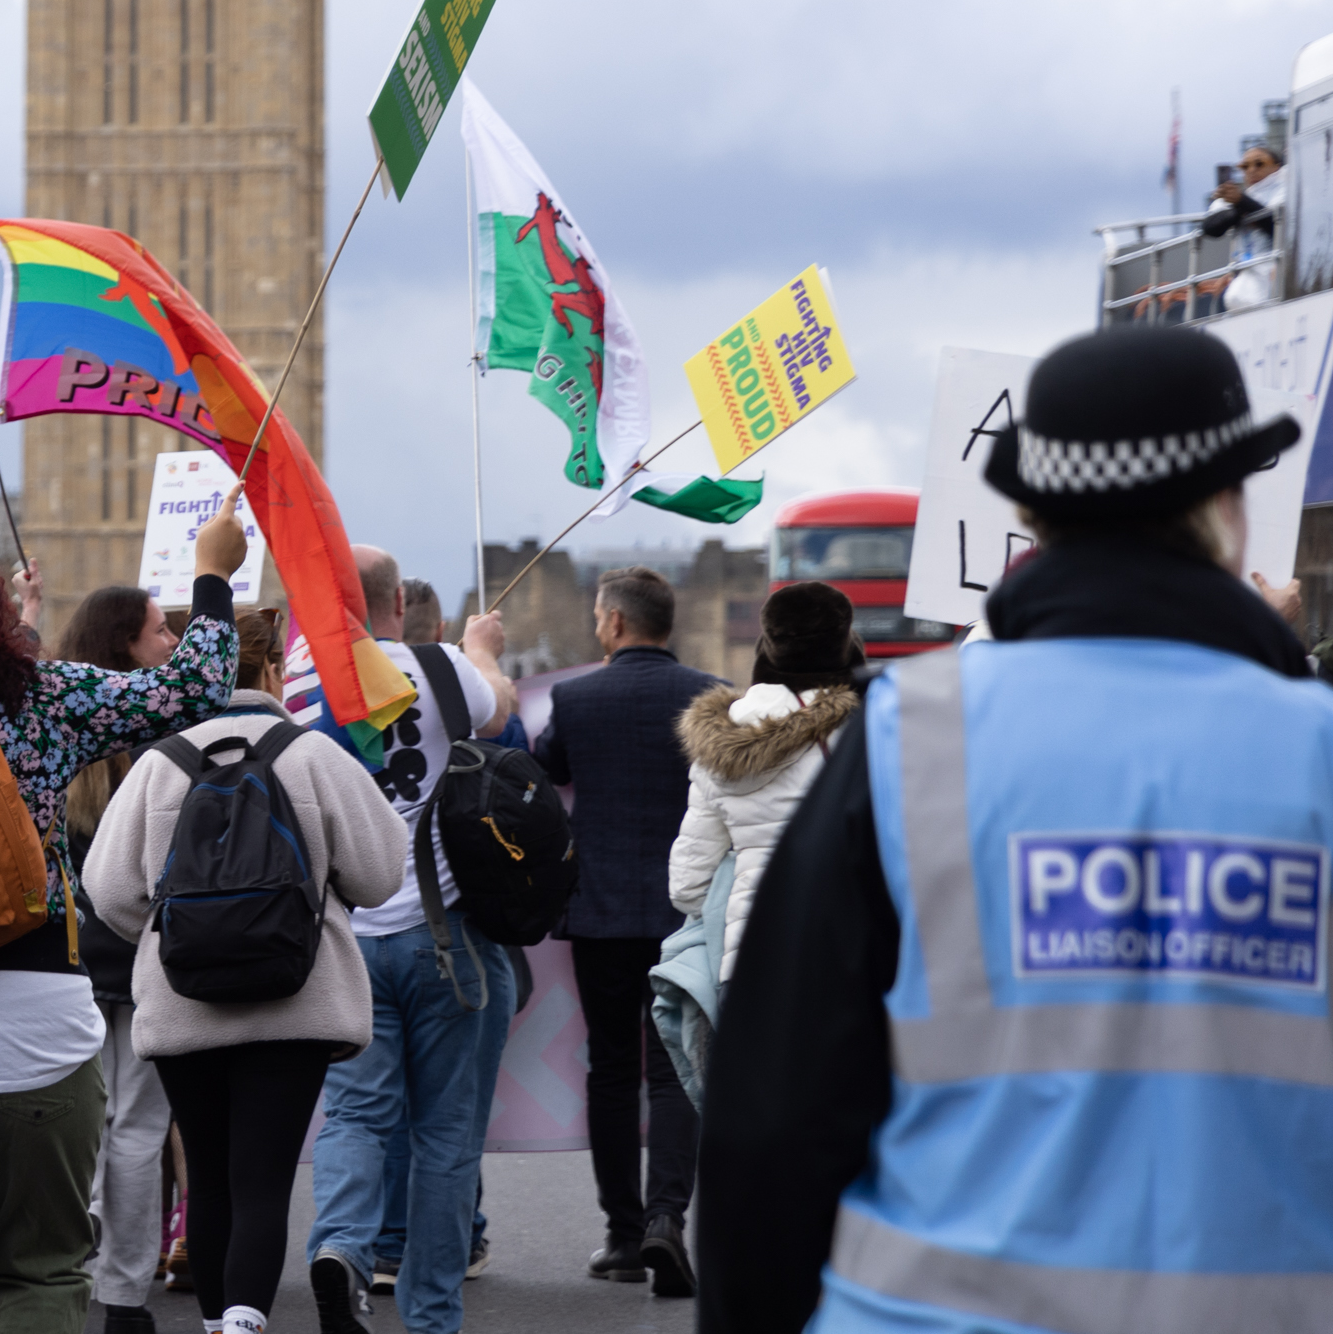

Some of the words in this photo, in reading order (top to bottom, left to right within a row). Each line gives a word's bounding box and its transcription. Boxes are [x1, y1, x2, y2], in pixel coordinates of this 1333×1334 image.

[417, 9, 431, 38] AND
[440, 1, 469, 75] STIGMA
[399, 29, 444, 142] SEXISM
[745, 317, 761, 343] AND
[790, 279, 833, 373] FIGHTING
[791, 330, 815, 368] HIV
[720, 326, 776, 441] PROUD
[775, 333, 811, 412] STIGMA
[1029, 846, 1316, 927] POLICE
[1029, 930, 1159, 963] LIAISON
[1166, 931, 1314, 975] OFFICER
